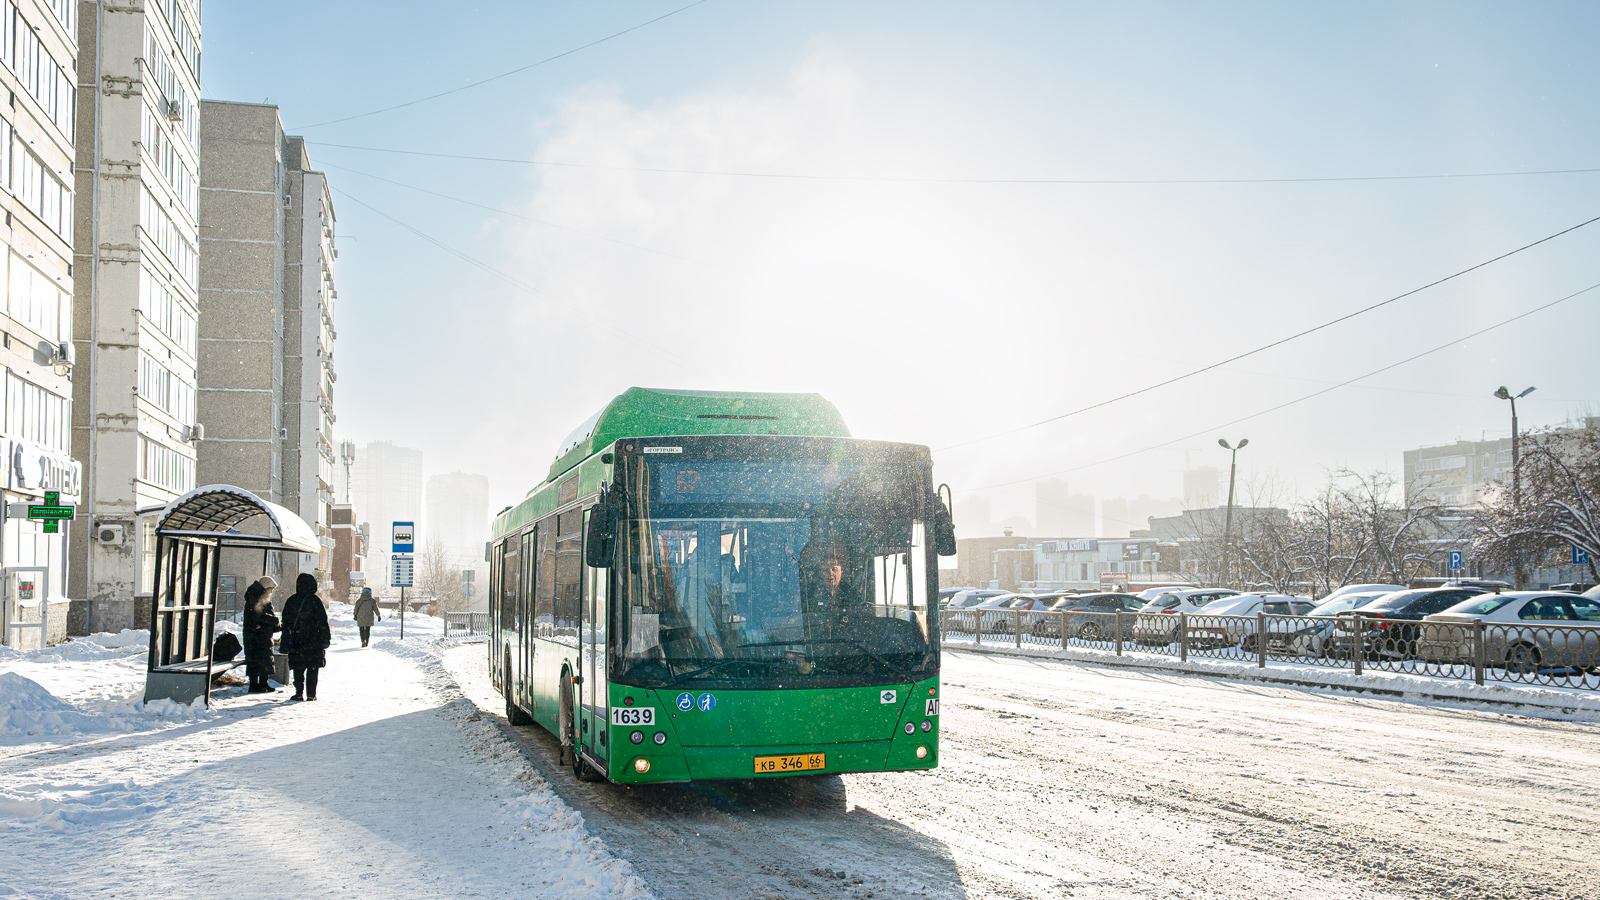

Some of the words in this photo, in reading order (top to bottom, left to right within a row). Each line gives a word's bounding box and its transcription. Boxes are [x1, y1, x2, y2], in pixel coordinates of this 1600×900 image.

[41, 454, 81, 497] АПТЕКА
[1452, 552, 1460, 568] P
[613, 708, 653, 724] 1639
[780, 756, 803, 770] 346
[809, 755, 821, 765] 66
